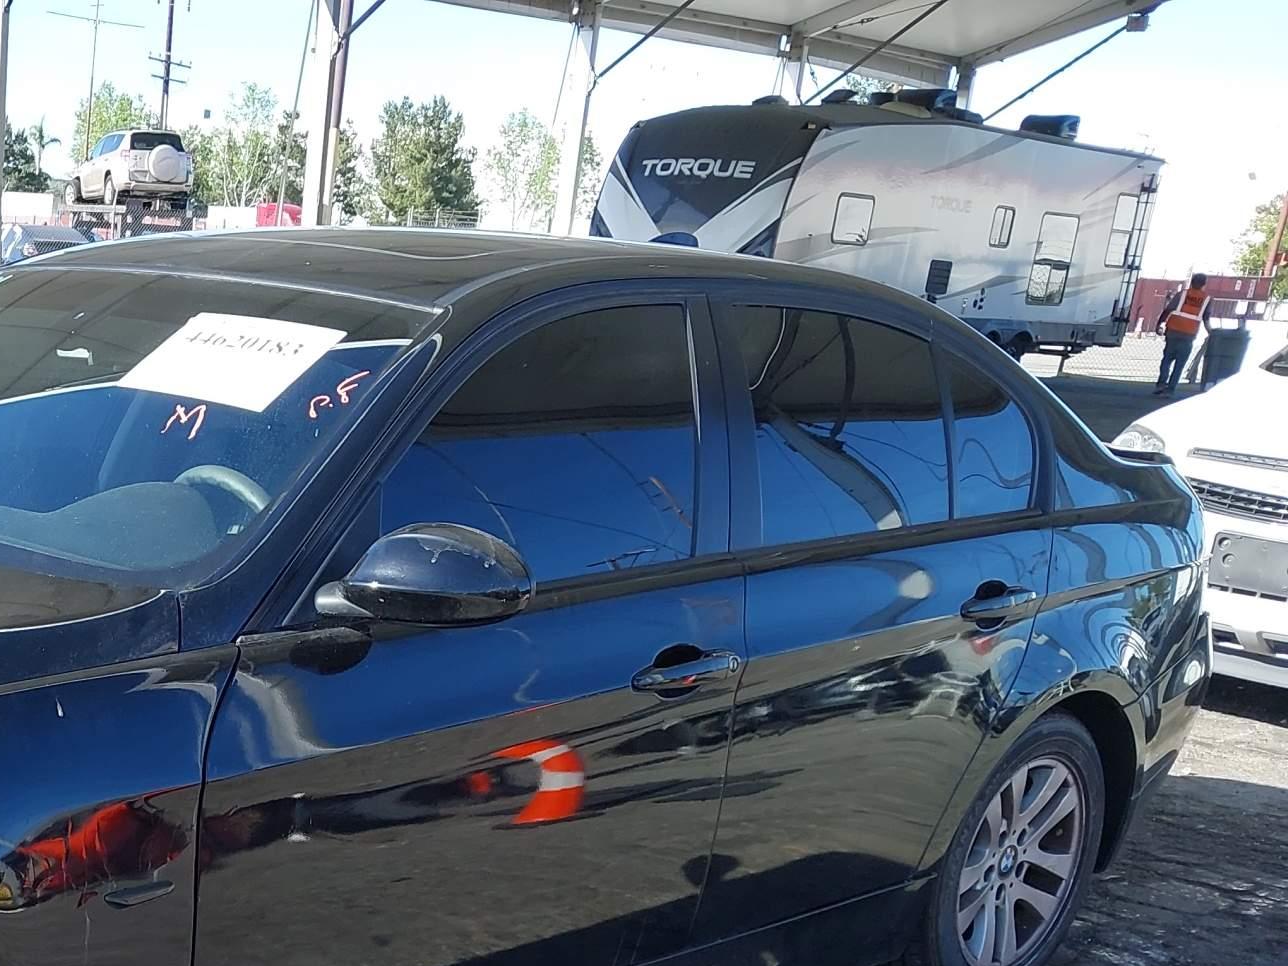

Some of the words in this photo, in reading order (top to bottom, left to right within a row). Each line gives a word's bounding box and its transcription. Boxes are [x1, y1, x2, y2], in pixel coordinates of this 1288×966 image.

[642, 157, 756, 179] TORQUE
[930, 194, 974, 214] TORQUE
[184, 331, 305, 355] 44620183
[160, 403, 207, 440] M
